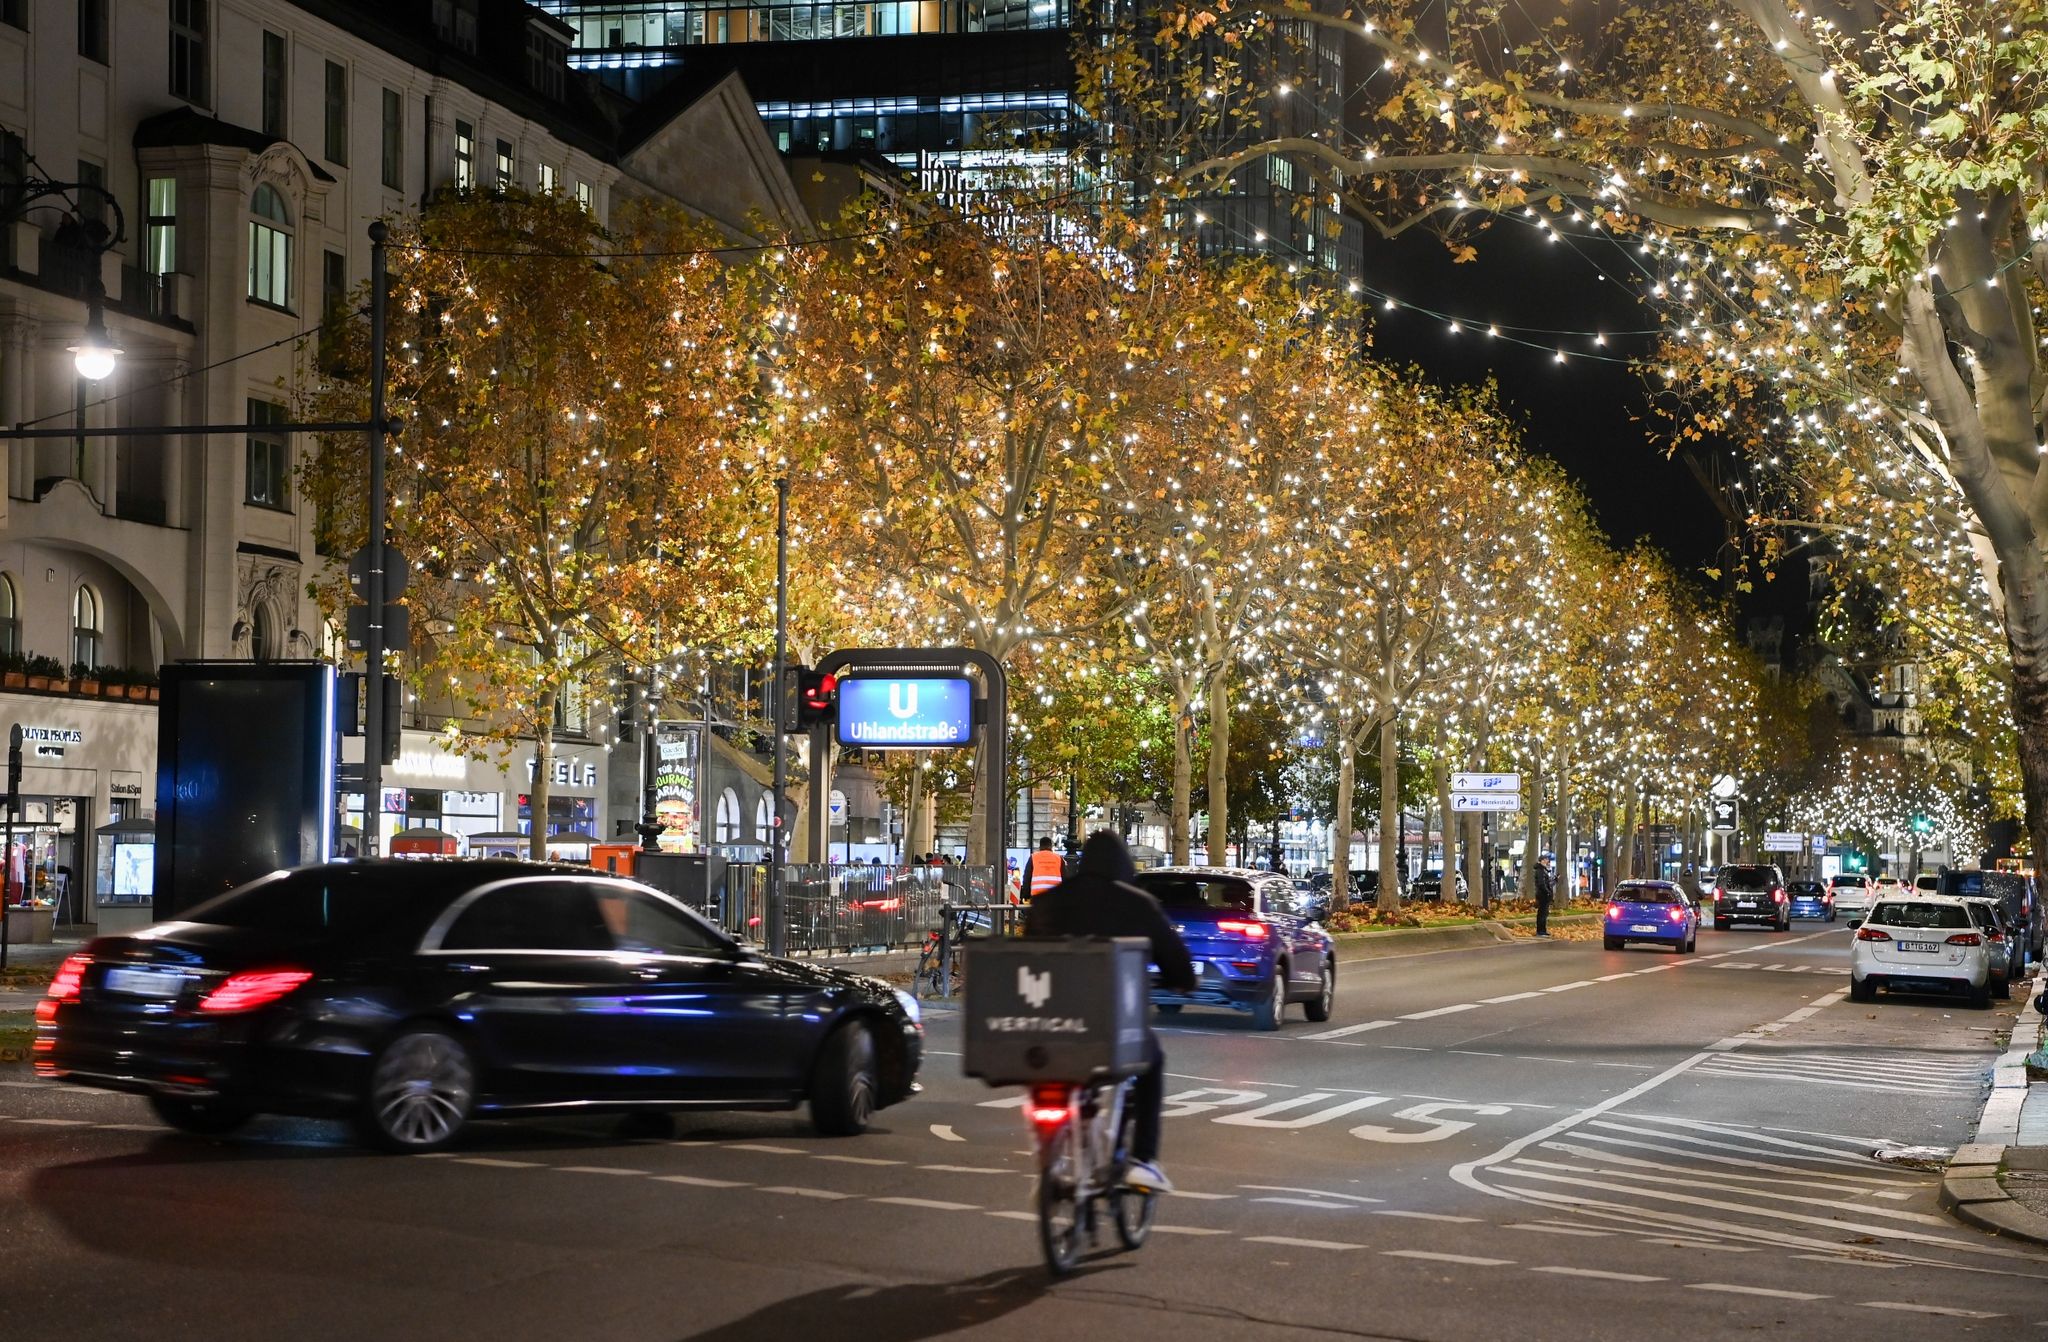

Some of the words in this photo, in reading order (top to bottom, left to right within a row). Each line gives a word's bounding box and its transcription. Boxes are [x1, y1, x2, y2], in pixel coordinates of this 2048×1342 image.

[889, 683, 918, 719] U
[22, 727, 49, 740] OLIVER
[50, 729, 82, 743] PEOPLES
[851, 721, 958, 740] Uhlandstraße
[658, 763, 673, 776] FÜR
[674, 764, 691, 777] ALLE
[985, 1016, 1089, 1033] VERTICAL
